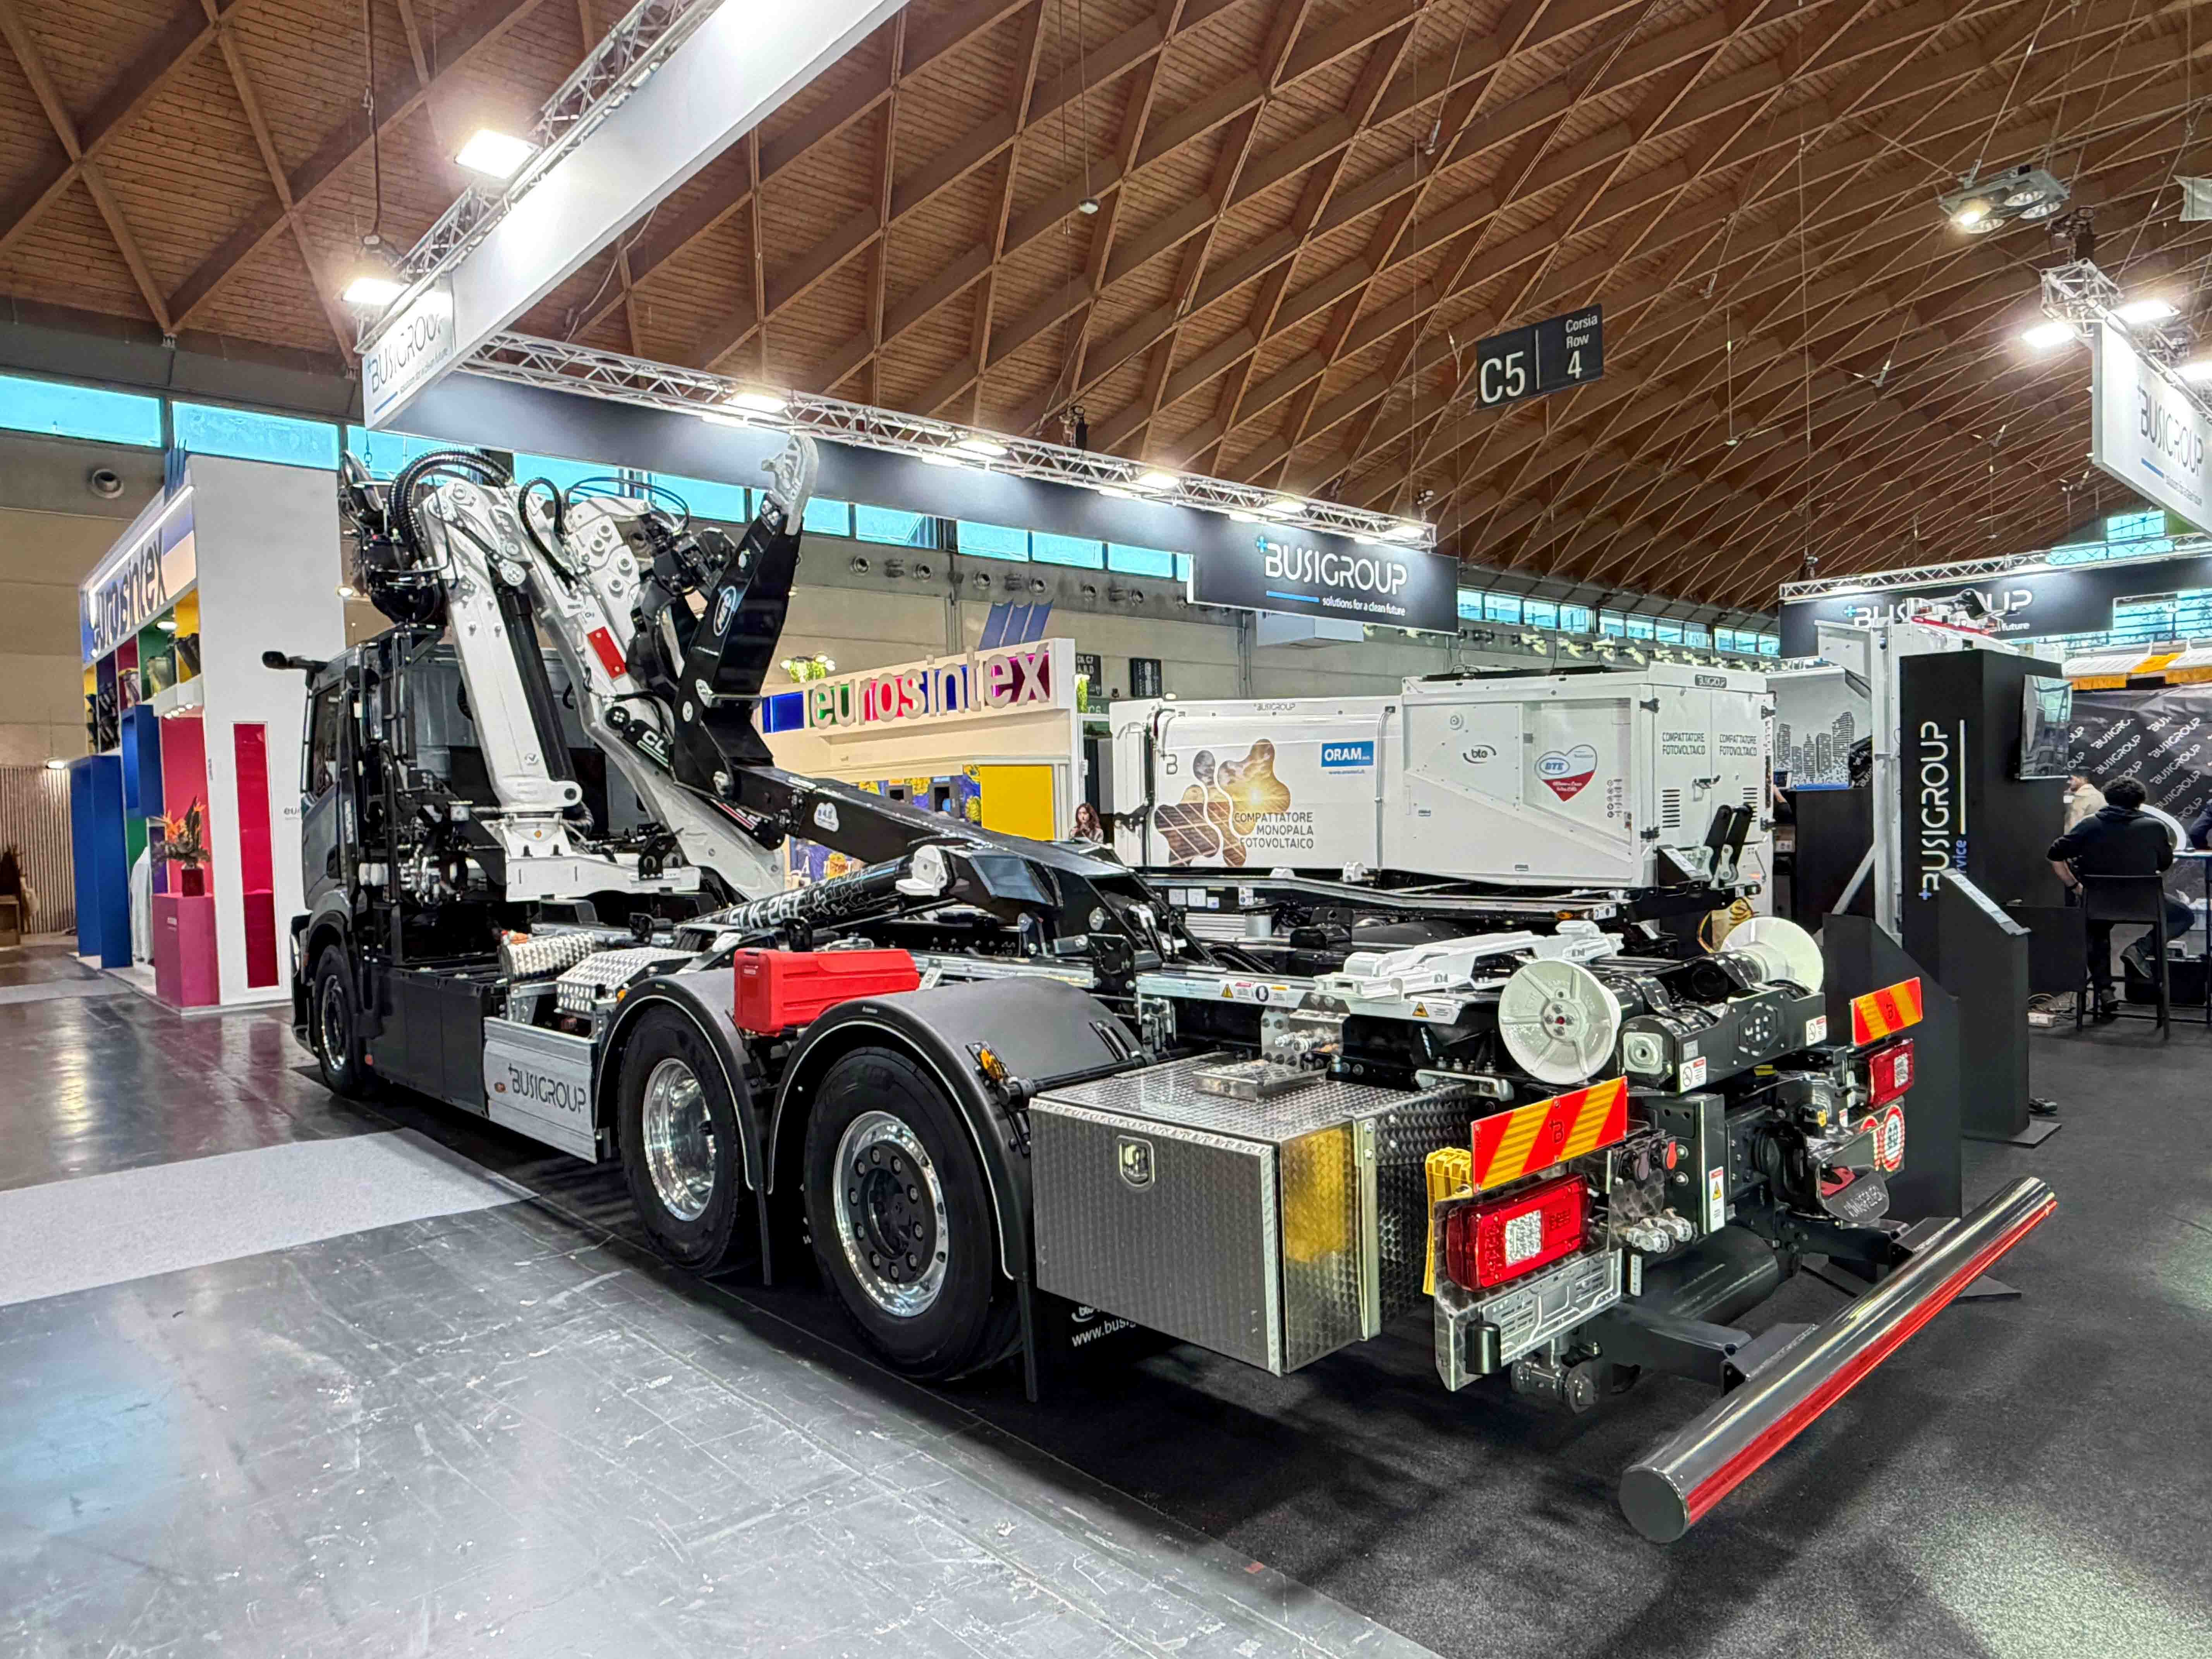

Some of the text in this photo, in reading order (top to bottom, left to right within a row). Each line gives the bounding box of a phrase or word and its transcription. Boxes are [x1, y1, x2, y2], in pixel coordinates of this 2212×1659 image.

[1565, 314, 1598, 333] Corsia
[1566, 333, 1589, 349] Row
[1567, 350, 1583, 379] 4
[1480, 351, 1526, 404] C5
[1265, 542, 1408, 595] BUSIGROUP
[1322, 596, 1406, 616] solutions for a clean future
[2001, 622, 2030, 632] future
[811, 642, 1050, 730] eurosintex
[1662, 732, 1705, 742] COMPATTATORE
[1719, 733, 1757, 744] COMPATTATORE
[2152, 717, 2201, 758] BUSIGROUP
[1324, 747, 1362, 762] ORAM
[1662, 744, 1706, 755] FOTOVOLTAICO
[1719, 745, 1757, 756] FOTOVOLTAICO
[2096, 734, 2141, 775] BUSIGROUP
[2153, 744, 2201, 785] BUSIGROUP
[1234, 812, 1313, 823] COMPATTATORE
[1256, 824, 1314, 836] MONOPALA
[1240, 838, 1314, 849] FOTOVOLTAICO
[511, 1069, 586, 1113] BUSIGROUP
